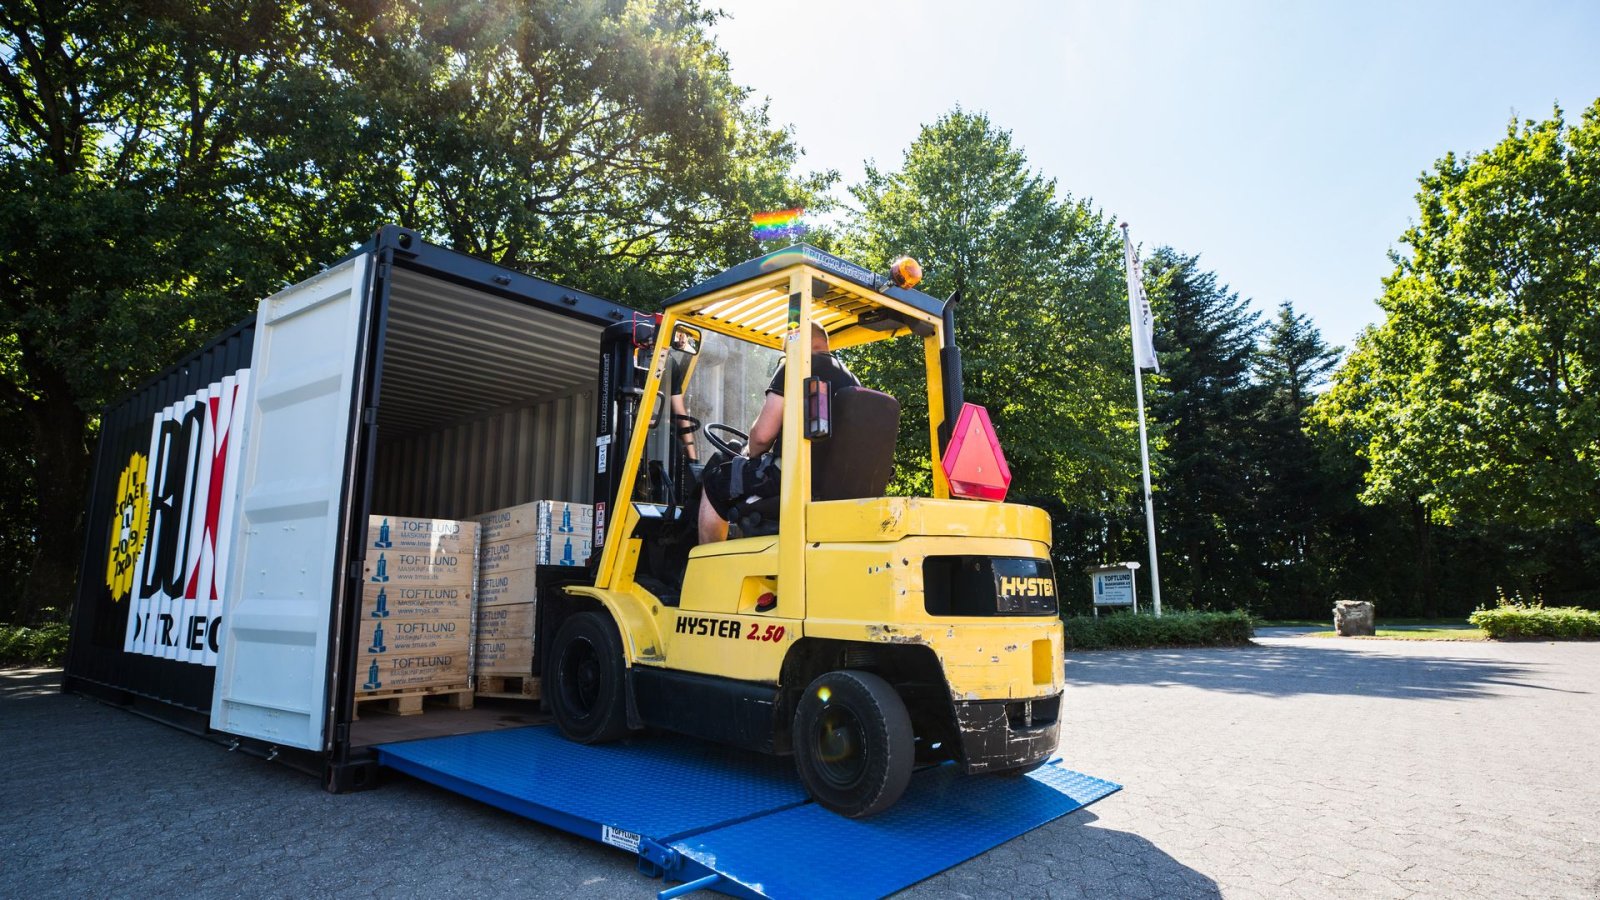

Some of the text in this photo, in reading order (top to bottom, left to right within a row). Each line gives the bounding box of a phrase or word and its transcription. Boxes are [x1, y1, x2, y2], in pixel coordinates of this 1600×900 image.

[401, 520, 460, 534] TOFTLUND
[399, 553, 458, 566] TOFTLUND
[399, 588, 458, 599] TOFTLUND
[396, 622, 456, 634] TOFTLUND
[675, 616, 785, 643] HYSTER 2.50
[391, 655, 453, 669] TOFTLUND
